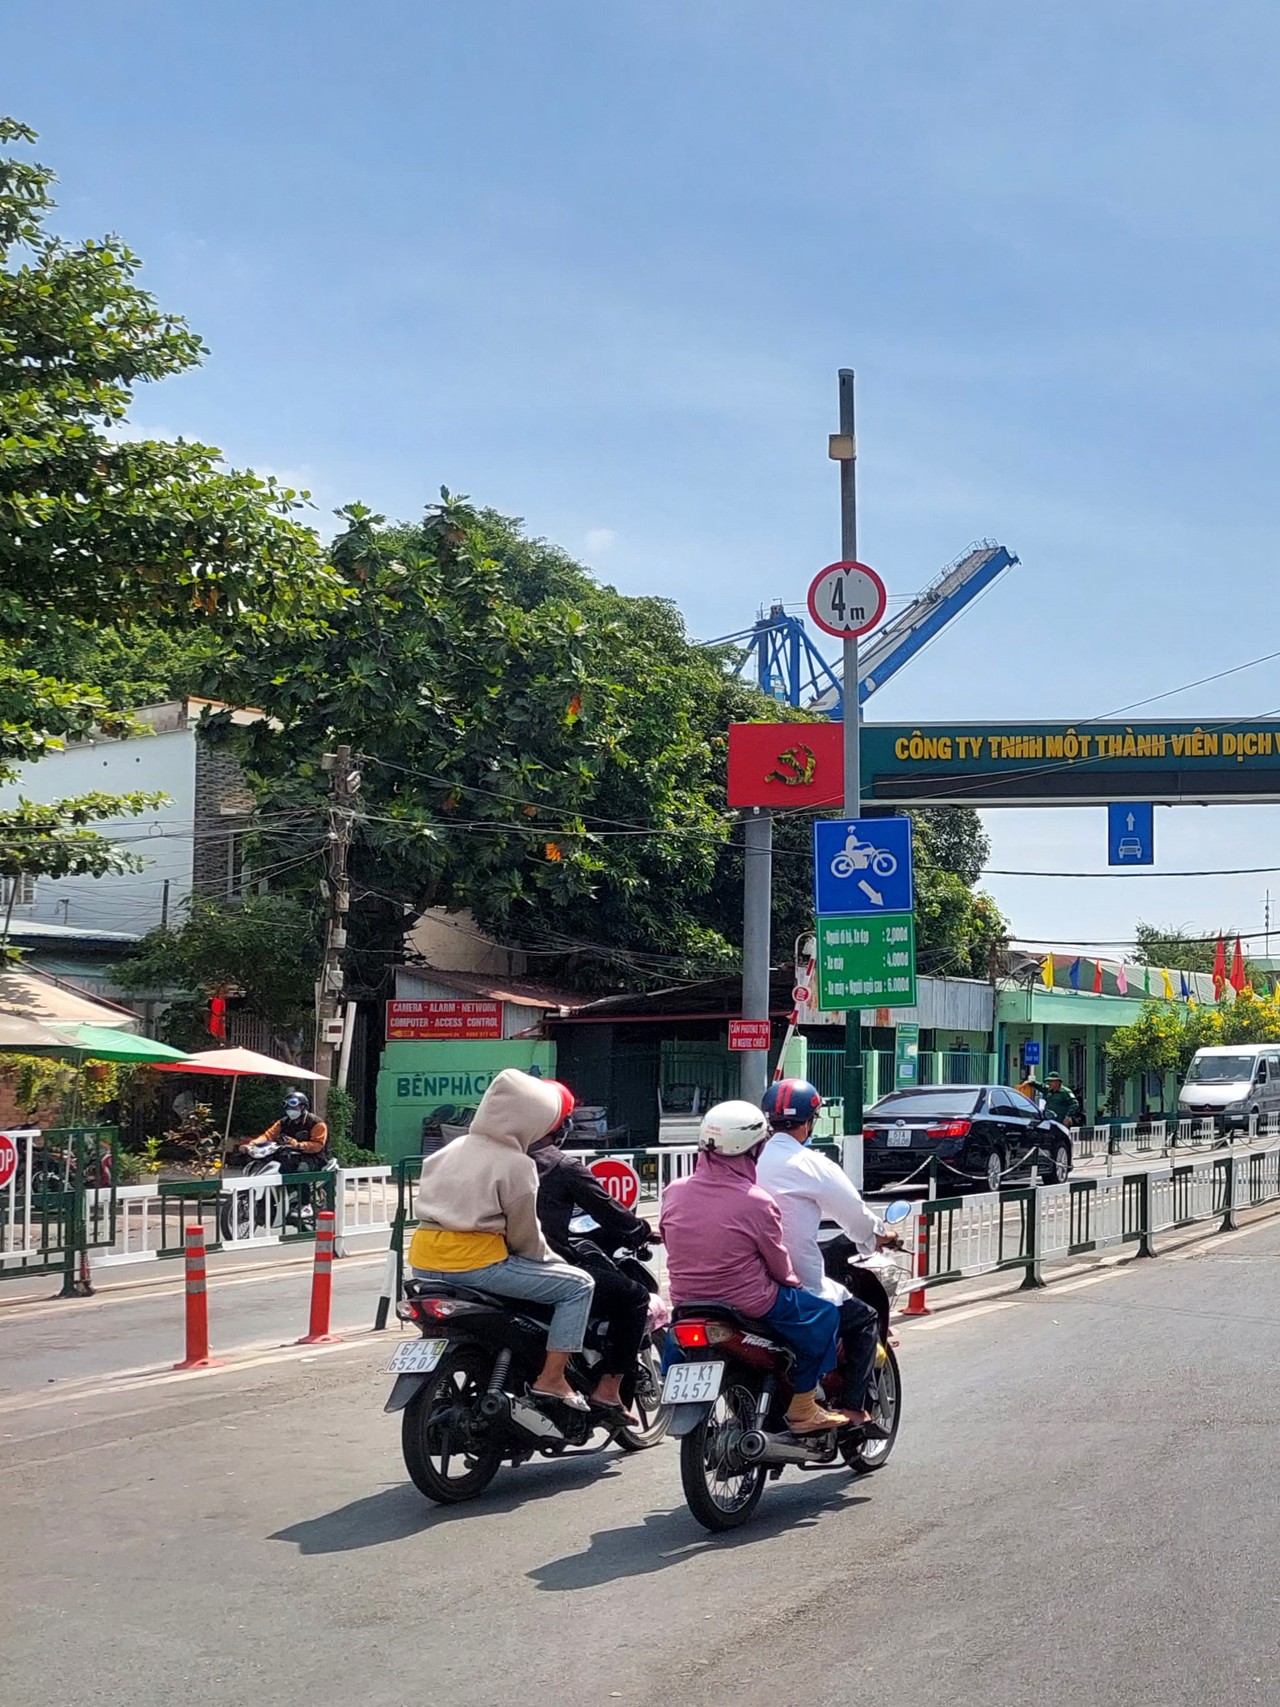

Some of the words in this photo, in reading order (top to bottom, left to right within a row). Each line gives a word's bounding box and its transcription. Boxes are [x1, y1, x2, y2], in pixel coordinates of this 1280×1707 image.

[895, 730, 951, 759] CÔNG
[956, 737, 983, 759] TY
[988, 736, 1043, 759] TNHH
[1046, 728, 1091, 764] MỘT
[1095, 727, 1166, 759] THÀNH
[1171, 727, 1218, 757] VIÊN
[1222, 733, 1272, 762] DỊCH
[393, 1002, 422, 1012] CAMERA
[429, 1002, 456, 1012] ALARM
[461, 1002, 497, 1012] NETWORK
[390, 1017, 428, 1027] COMPUTER
[434, 1017, 462, 1027] ACCESS
[467, 1017, 497, 1027] CONTROL
[0, 1148, 14, 1172] OP
[596, 1176, 634, 1202] TOP
[389, 1356, 436, 1371] 652.07
[675, 1365, 713, 1382] 51-K1
[671, 1382, 711, 1400] 3457
